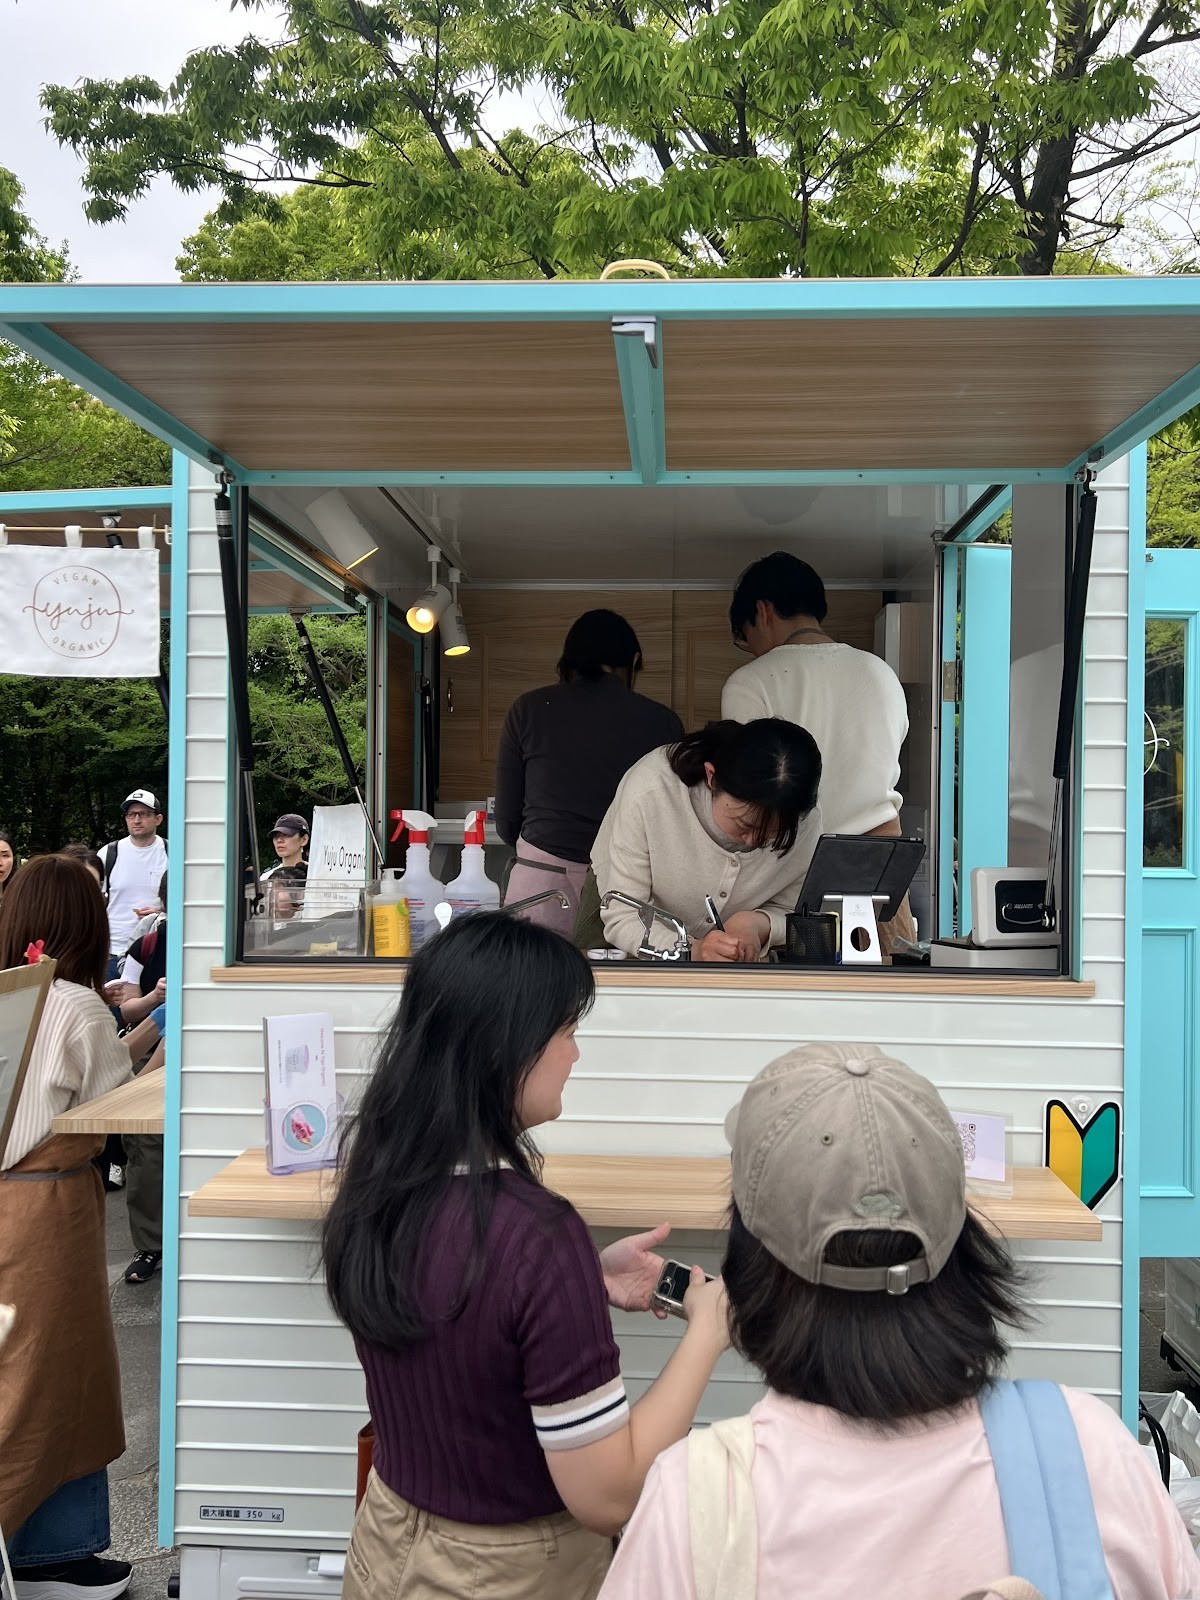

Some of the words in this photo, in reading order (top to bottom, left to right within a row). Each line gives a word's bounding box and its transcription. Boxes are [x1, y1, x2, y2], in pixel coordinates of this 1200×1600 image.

[53, 572, 100, 586] VEGAN
[22, 597, 135, 631] yuju
[52, 636, 107, 652] ORGANIC
[323, 845, 338, 872] Yuju
[202, 1508, 240, 1518] 最大積載量
[246, 1510, 263, 1519] 350
[271, 1512, 281, 1521] kg
